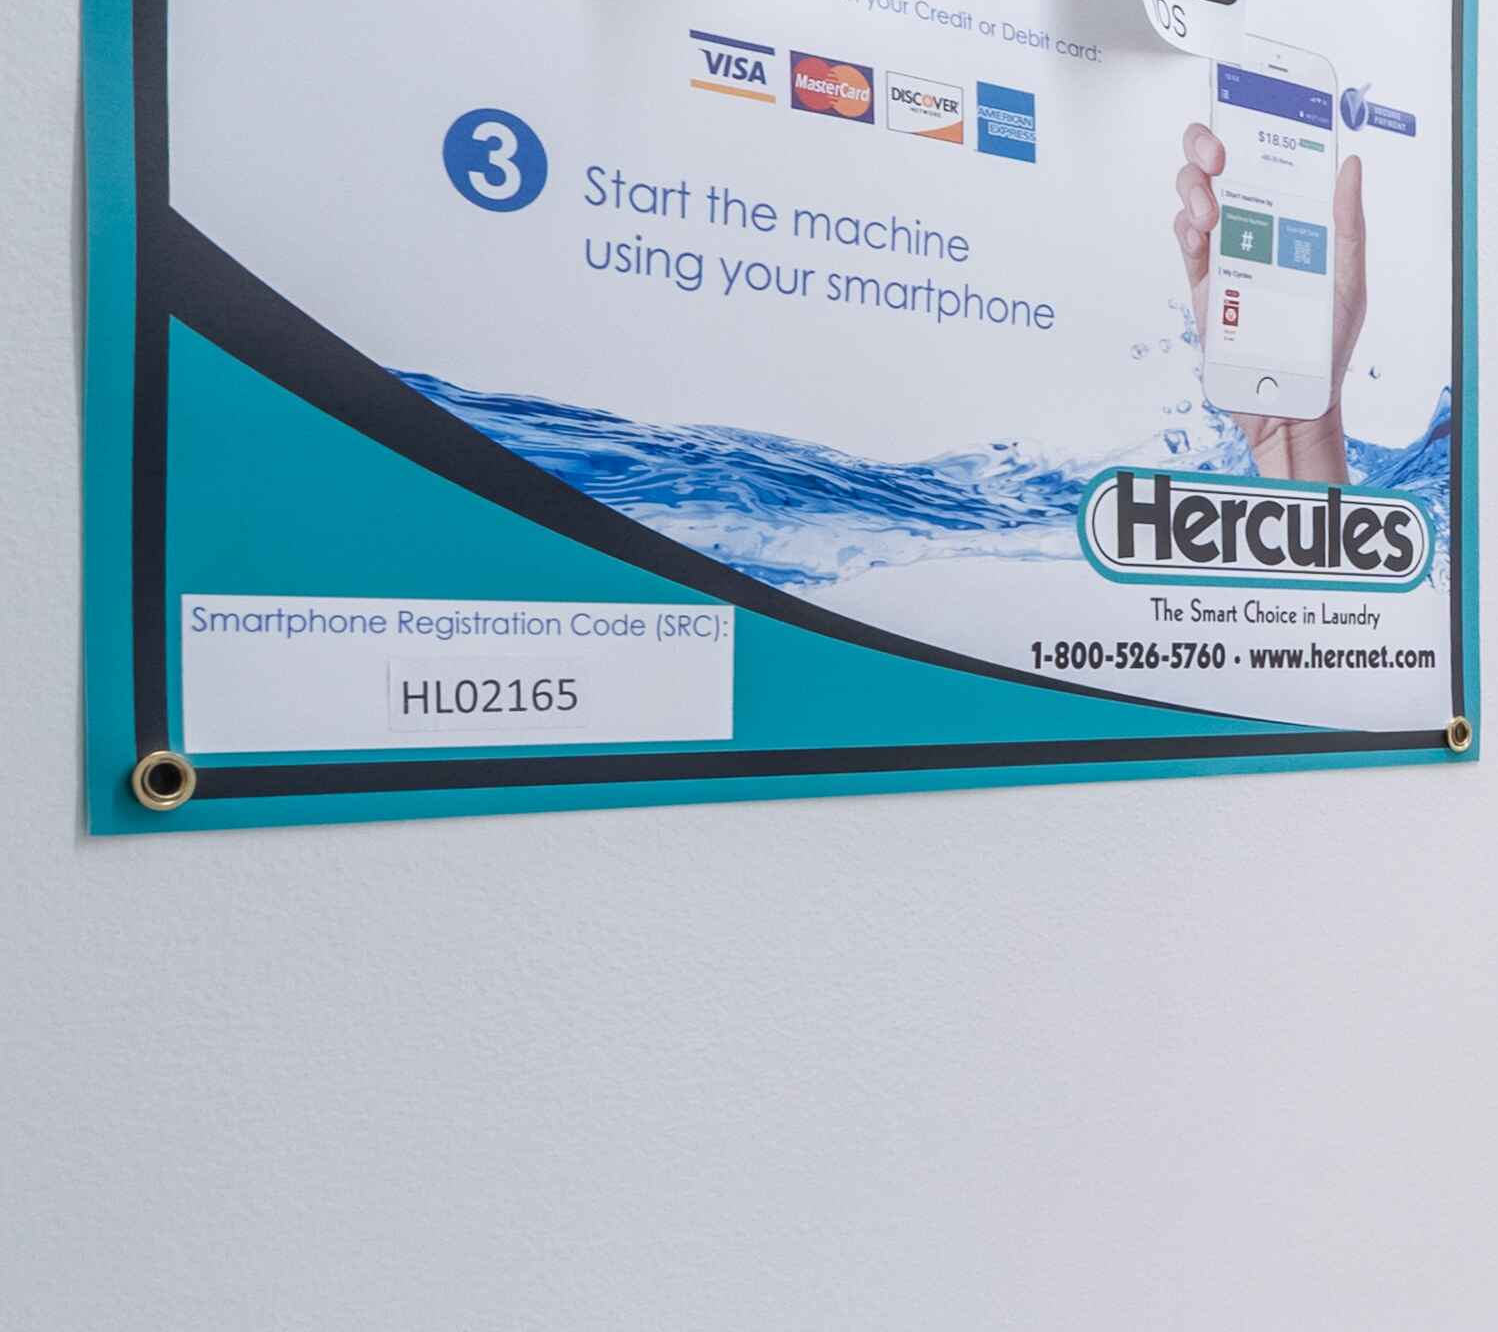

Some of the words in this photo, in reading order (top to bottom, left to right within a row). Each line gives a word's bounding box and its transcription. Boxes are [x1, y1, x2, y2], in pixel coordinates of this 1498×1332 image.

[914, 0, 973, 32] Credit
[978, 18, 998, 36] or
[1001, 20, 1052, 51] Debit
[1055, 38, 1103, 64] card:
[698, 48, 767, 85] VISA
[795, 72, 870, 102] MasterCard
[891, 86, 959, 114] DISCOVER
[978, 107, 1034, 128] AMERICAN
[988, 124, 1037, 142] EXPRESS
[1257, 130, 1297, 152] $18.50
[468, 121, 522, 201] 3
[584, 164, 690, 220] Start
[706, 184, 778, 232] the
[793, 205, 970, 263] machine
[584, 234, 704, 291] using
[720, 256, 815, 297] your
[826, 269, 1056, 330] smartphone
[1116, 471, 1414, 573] Hercules
[191, 606, 387, 638] Smartphone
[397, 609, 562, 640] Registration
[570, 612, 646, 638] Code
[656, 613, 729, 643] (SRC):
[1150, 597, 1183, 623] The
[1191, 598, 1237, 623] Smart
[1244, 599, 1297, 625] Choice
[1303, 602, 1316, 625] in
[1321, 603, 1381, 630] Laundry
[1031, 640, 1226, 670] 1-800-526-5760
[1250, 642, 1436, 670] www.hercnet.com
[402, 677, 579, 715] HL02165
